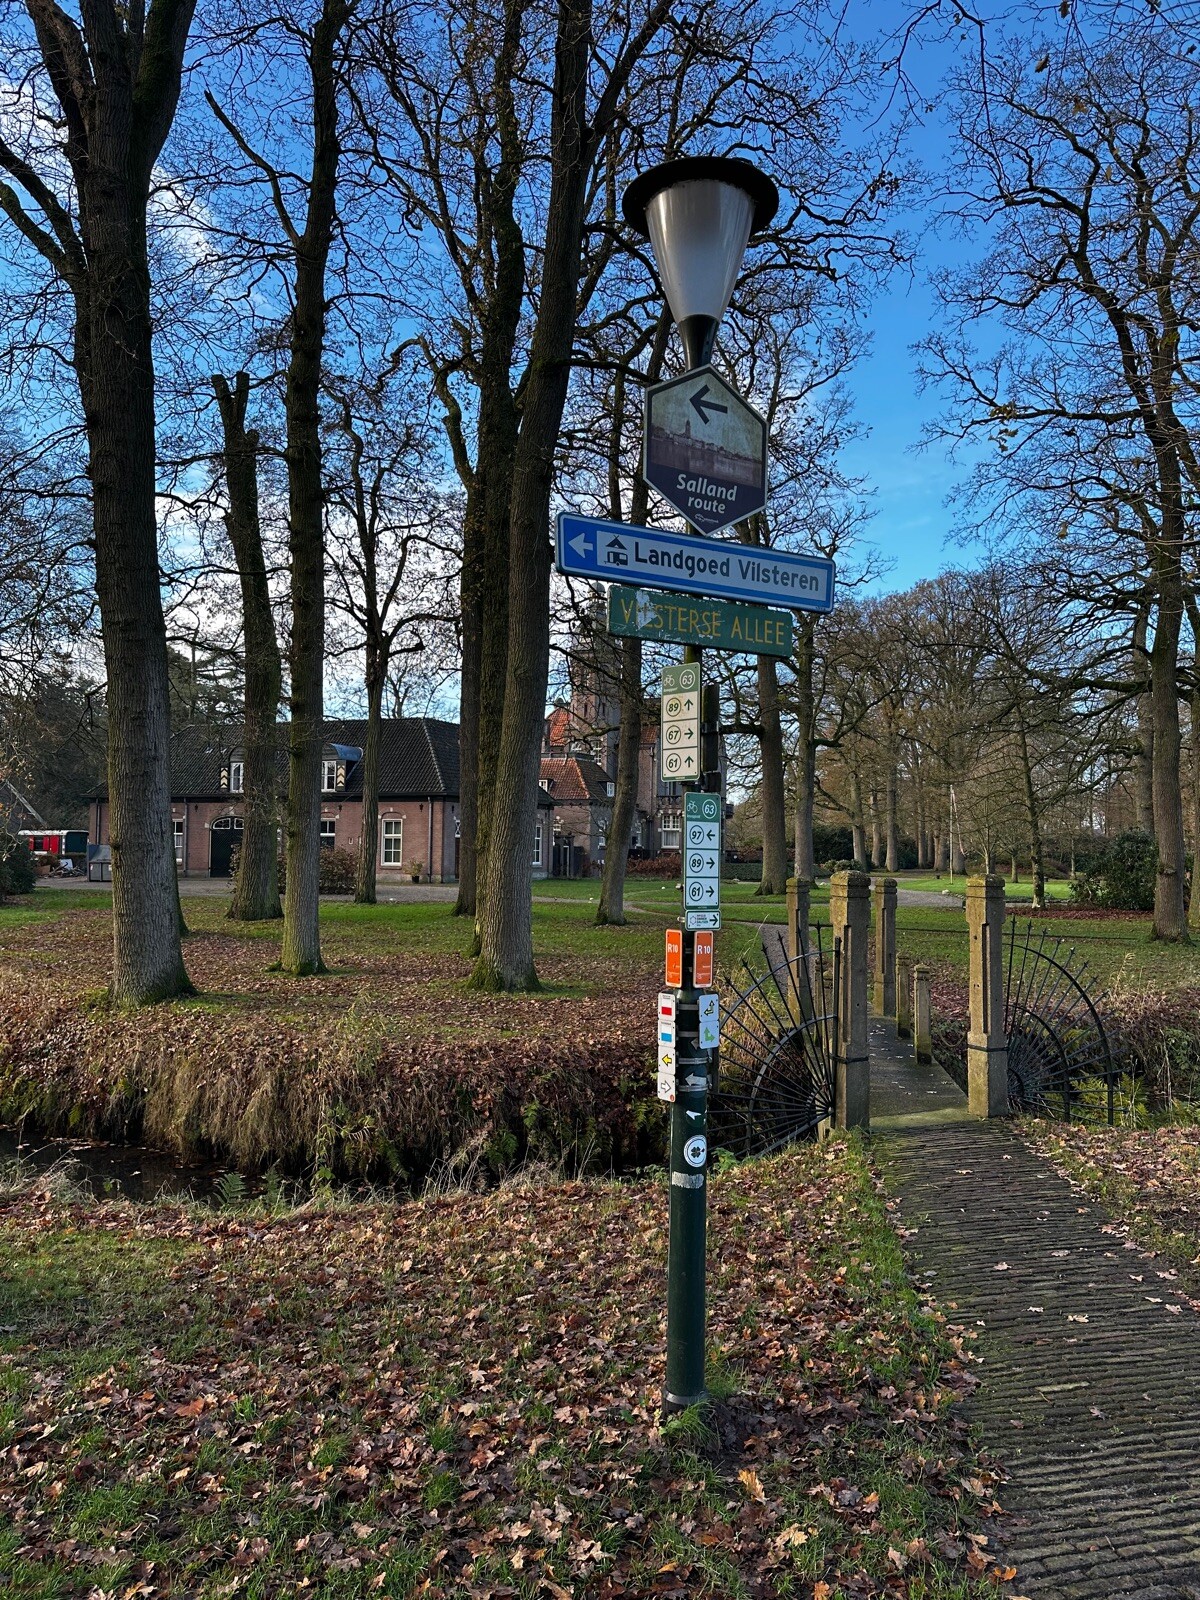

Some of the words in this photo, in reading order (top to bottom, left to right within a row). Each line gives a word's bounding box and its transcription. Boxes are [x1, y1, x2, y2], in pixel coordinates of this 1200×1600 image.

[676, 473, 738, 502] Salland
[687, 496, 726, 514] route
[634, 541, 731, 578] Landgoed
[737, 559, 819, 592] Vilsteren
[730, 615, 785, 646] ALLEE
[682, 674, 693, 685] 63
[668, 702, 679, 713] 89
[668, 730, 679, 741] 67
[668, 757, 678, 768] 61
[704, 804, 715, 815] 63
[691, 830, 702, 840] 97
[691, 858, 702, 868] 89
[691, 886, 701, 897] 61
